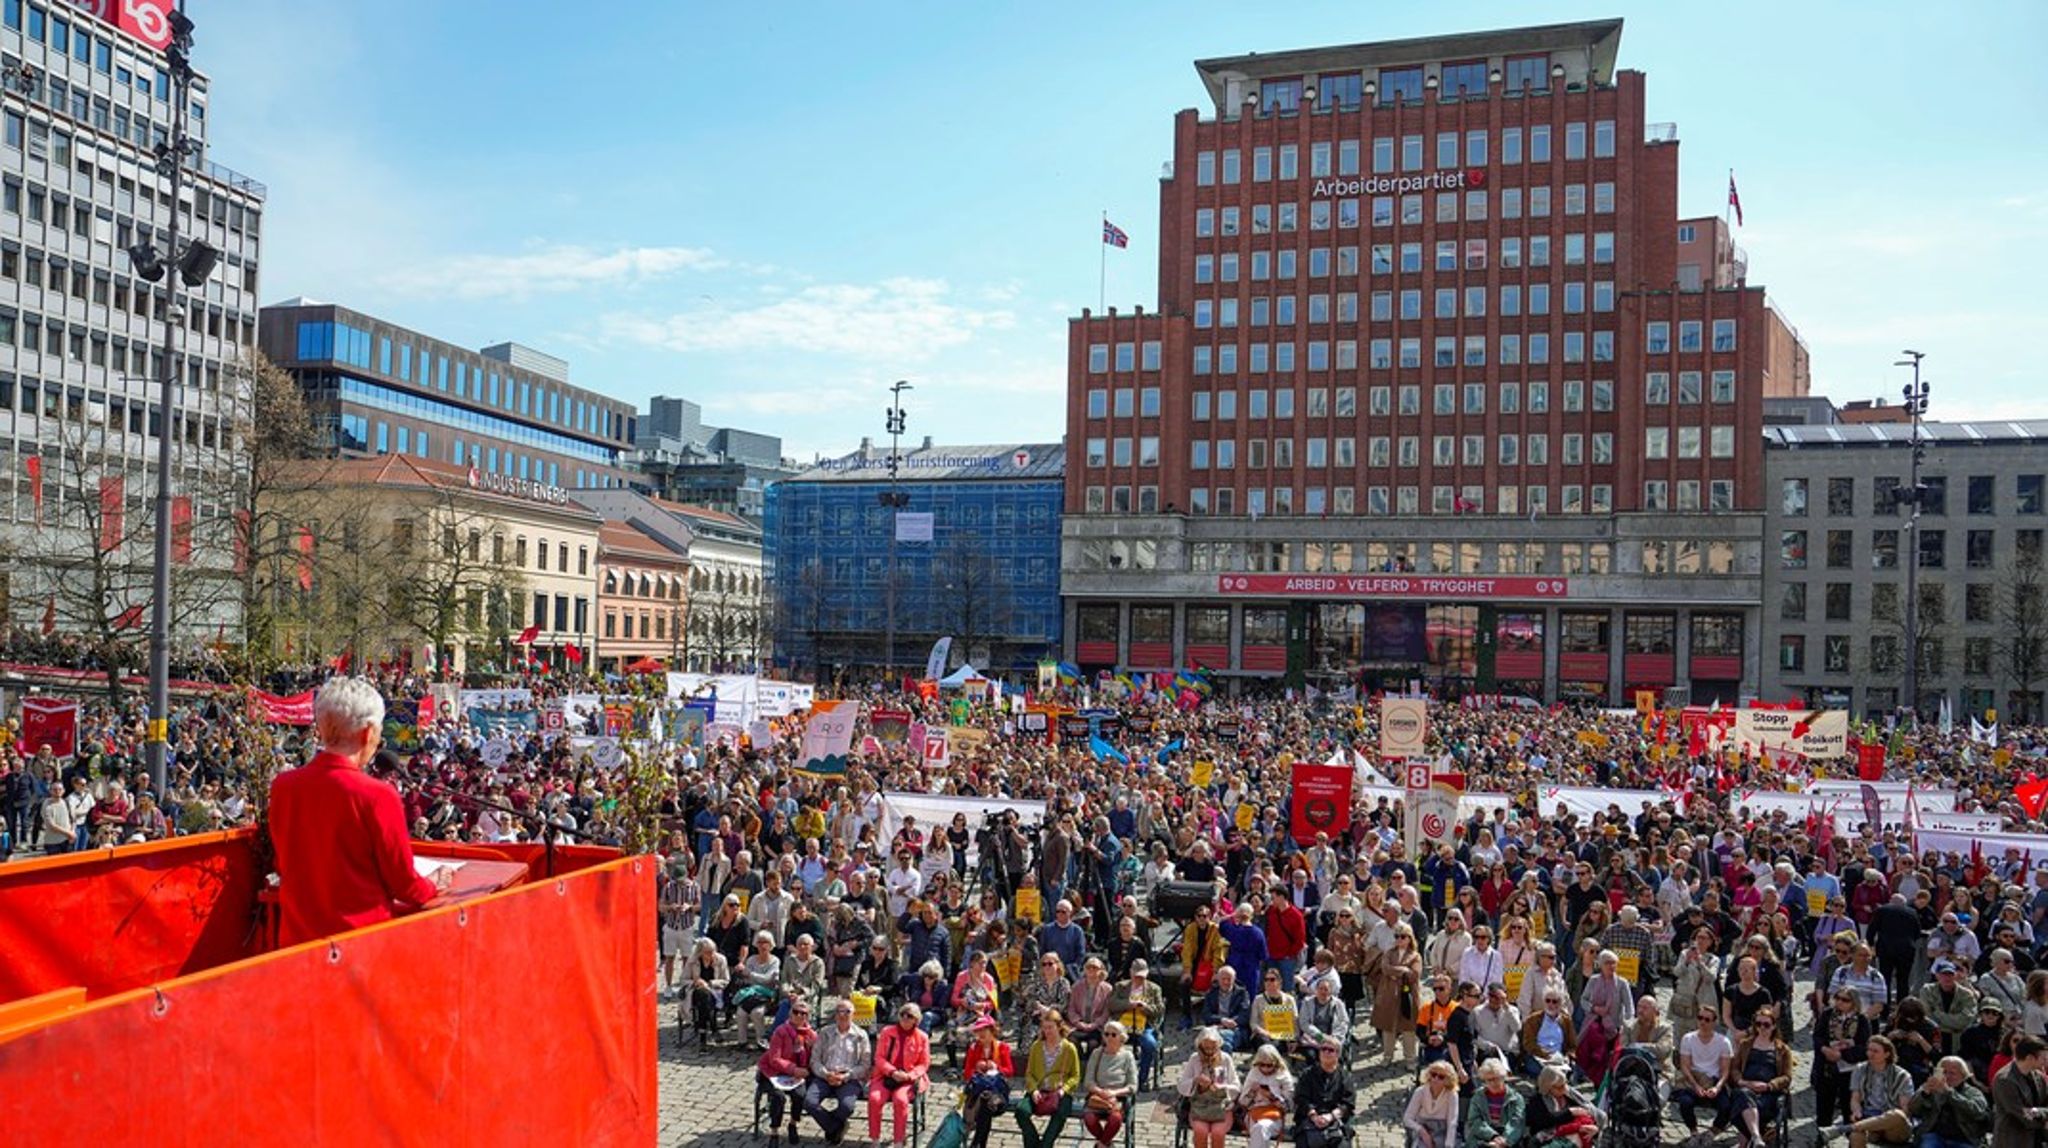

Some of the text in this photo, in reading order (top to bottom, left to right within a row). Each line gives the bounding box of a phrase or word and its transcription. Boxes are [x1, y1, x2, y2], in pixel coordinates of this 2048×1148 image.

[1312, 170, 1465, 198] Arbeiderpartiet
[904, 455, 999, 471] Turistforening
[1285, 578, 1496, 593] ARBEID VELFERD TRYGGHET
[549, 712, 560, 726] 6
[1752, 712, 1789, 724] Stopp
[1803, 734, 1843, 744] Boikott
[928, 740, 943, 759] 7
[1410, 767, 1427, 788] 8
